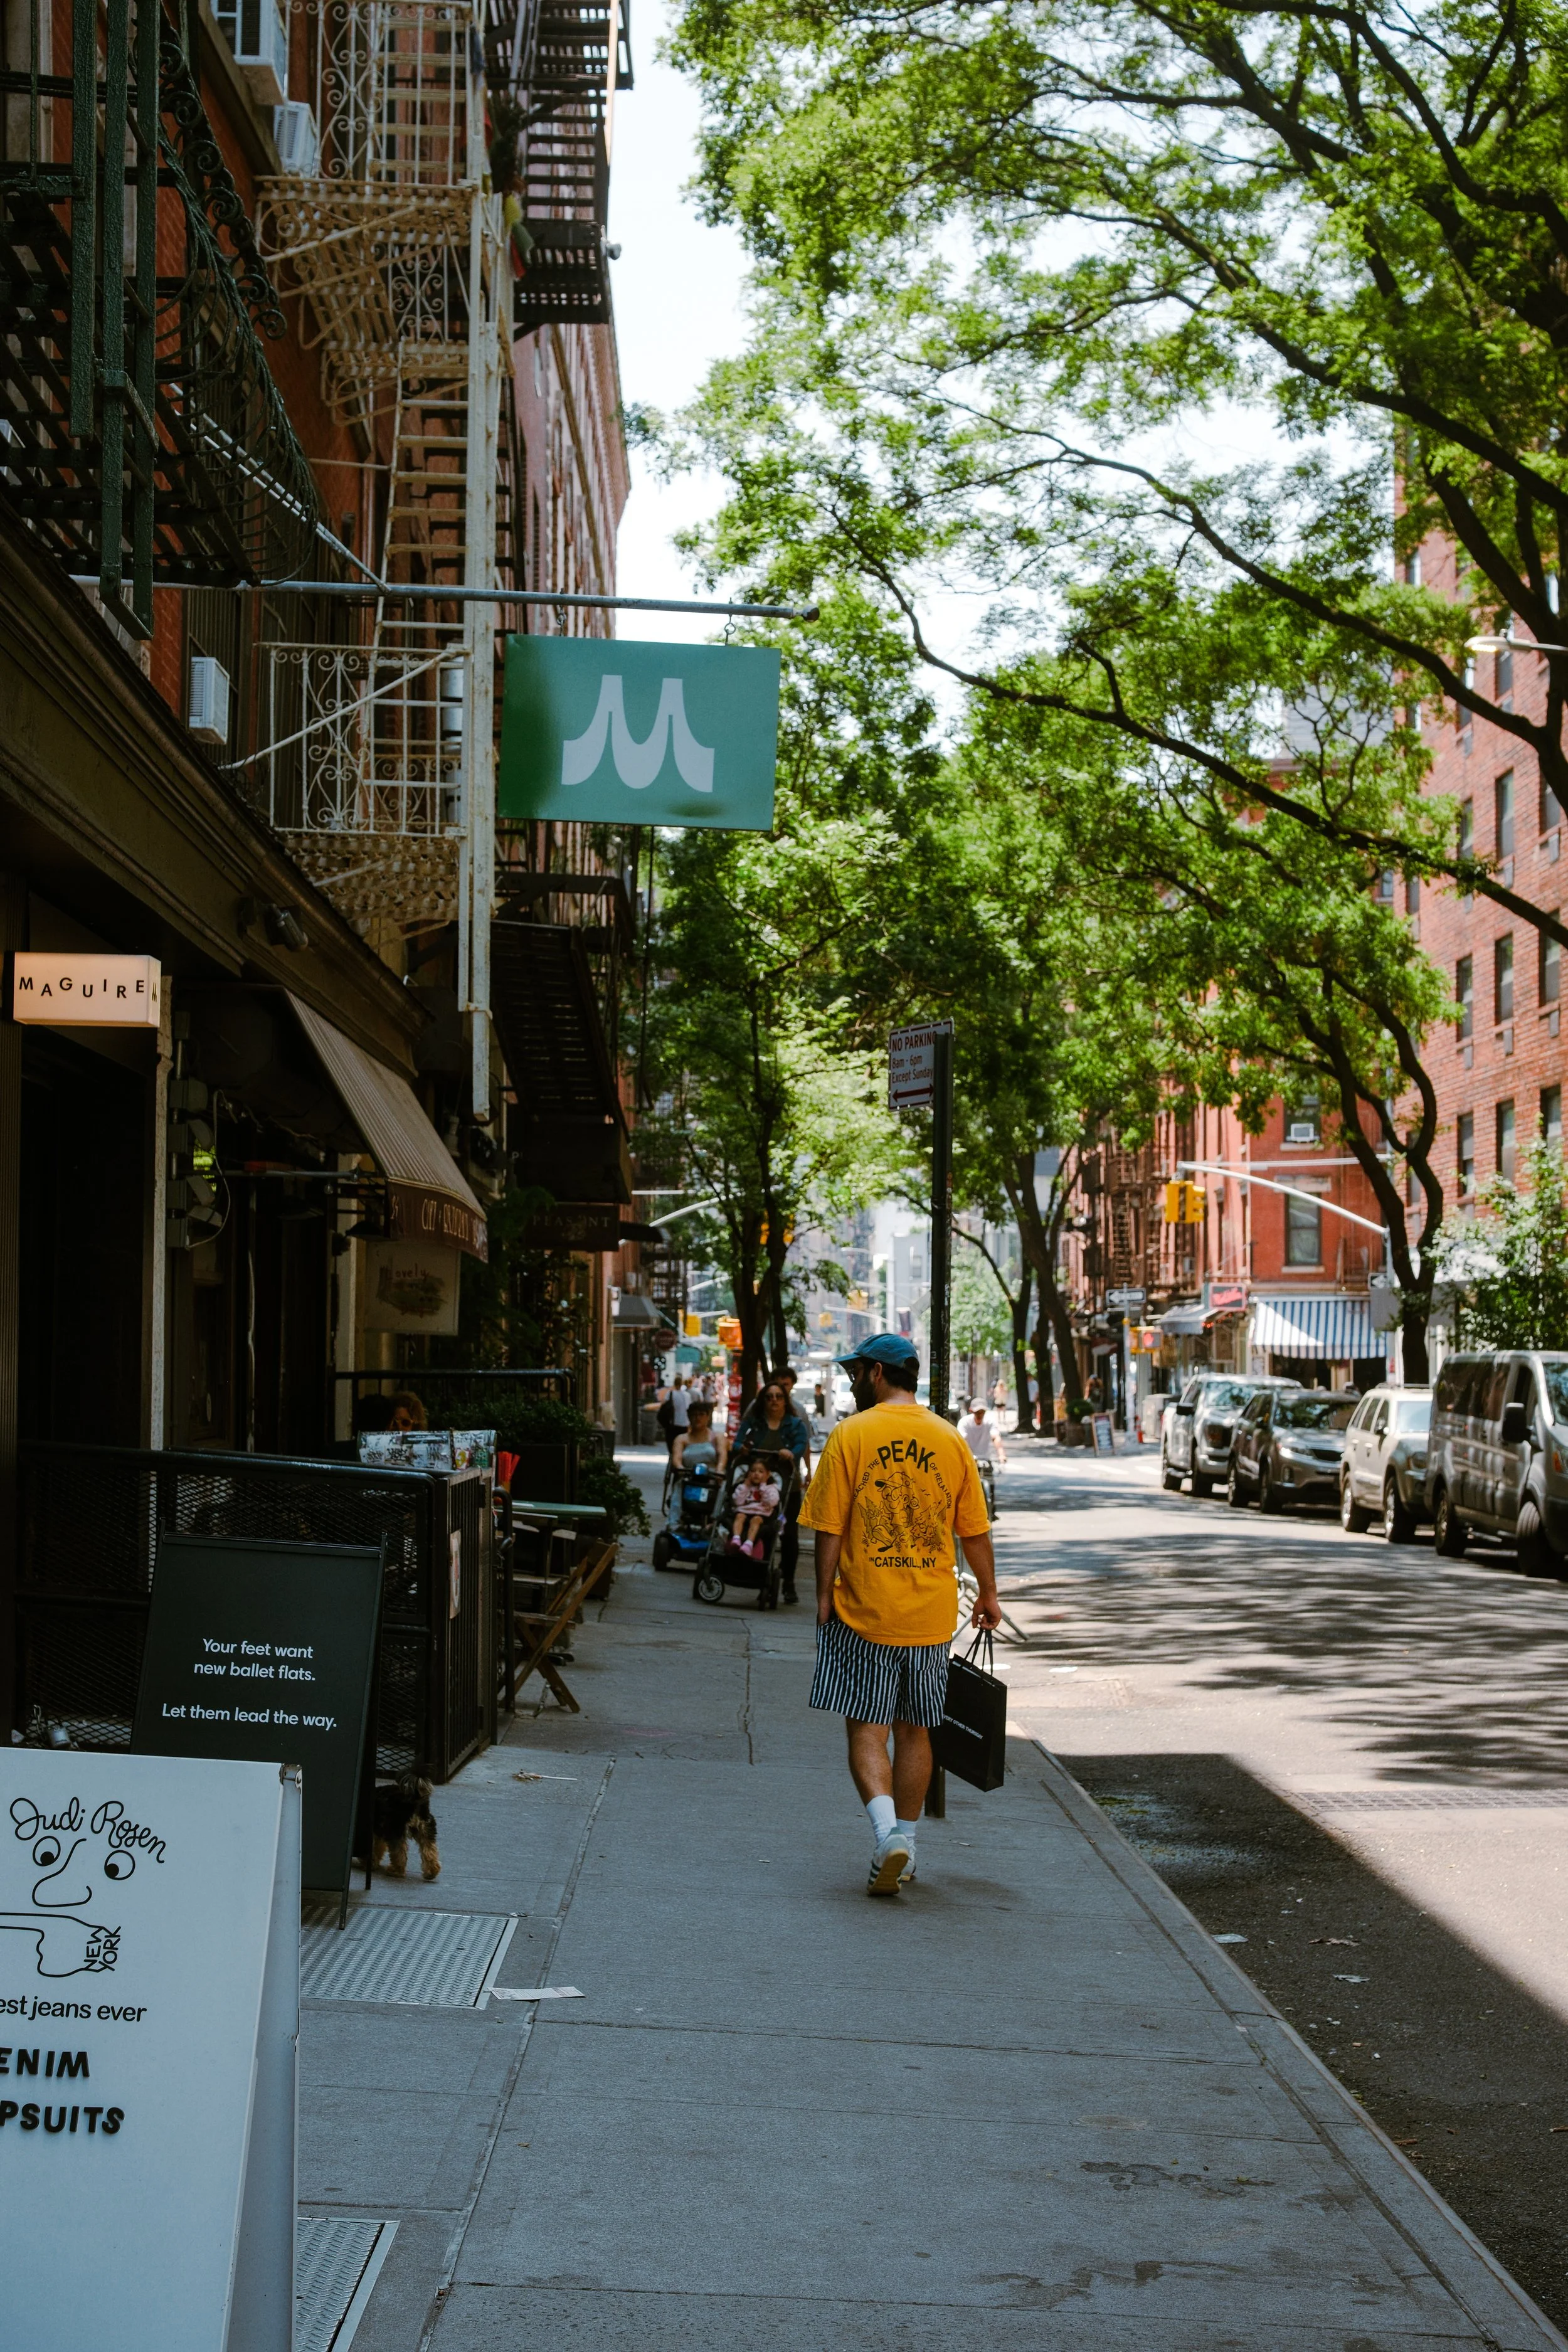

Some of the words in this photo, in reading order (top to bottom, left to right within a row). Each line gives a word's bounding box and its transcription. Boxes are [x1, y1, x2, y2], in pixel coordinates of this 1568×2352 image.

[19, 977, 144, 998] MAGUIRE
[892, 1038, 903, 1052] NO
[892, 1057, 904, 1069] 8am
[910, 1054, 923, 1067] 6pm
[892, 1069, 911, 1084] Except
[913, 1067, 934, 1080] Sunday
[867, 1458, 880, 1470] THE
[877, 1438, 936, 1473] PEAK
[930, 1462, 938, 1471] OF
[922, 1557, 936, 1569] NY
[203, 1638, 237, 1653] Your
[240, 1640, 271, 1656] feet
[275, 1645, 314, 1659] want
[194, 1663, 226, 1676] new
[230, 1662, 275, 1678] ballet
[278, 1665, 315, 1681] flats.
[162, 1703, 186, 1719] Let
[189, 1704, 230, 1721] them
[235, 1707, 270, 1724] lead
[273, 1710, 299, 1725] the
[302, 1714, 337, 1731] way.
[943, 1714, 953, 1723] VERY
[9, 1796, 86, 1841] Judi
[90, 1800, 166, 1863] Rosen
[83, 1926, 105, 1973] NEW
[98, 1926, 122, 1972] YORK
[0, 1995, 28, 2015] est
[28, 1996, 92, 2021] jeans
[97, 2005, 147, 2022] ever
[0, 2047, 90, 2078] ENIM
[0, 2100, 125, 2134] PSUITS
